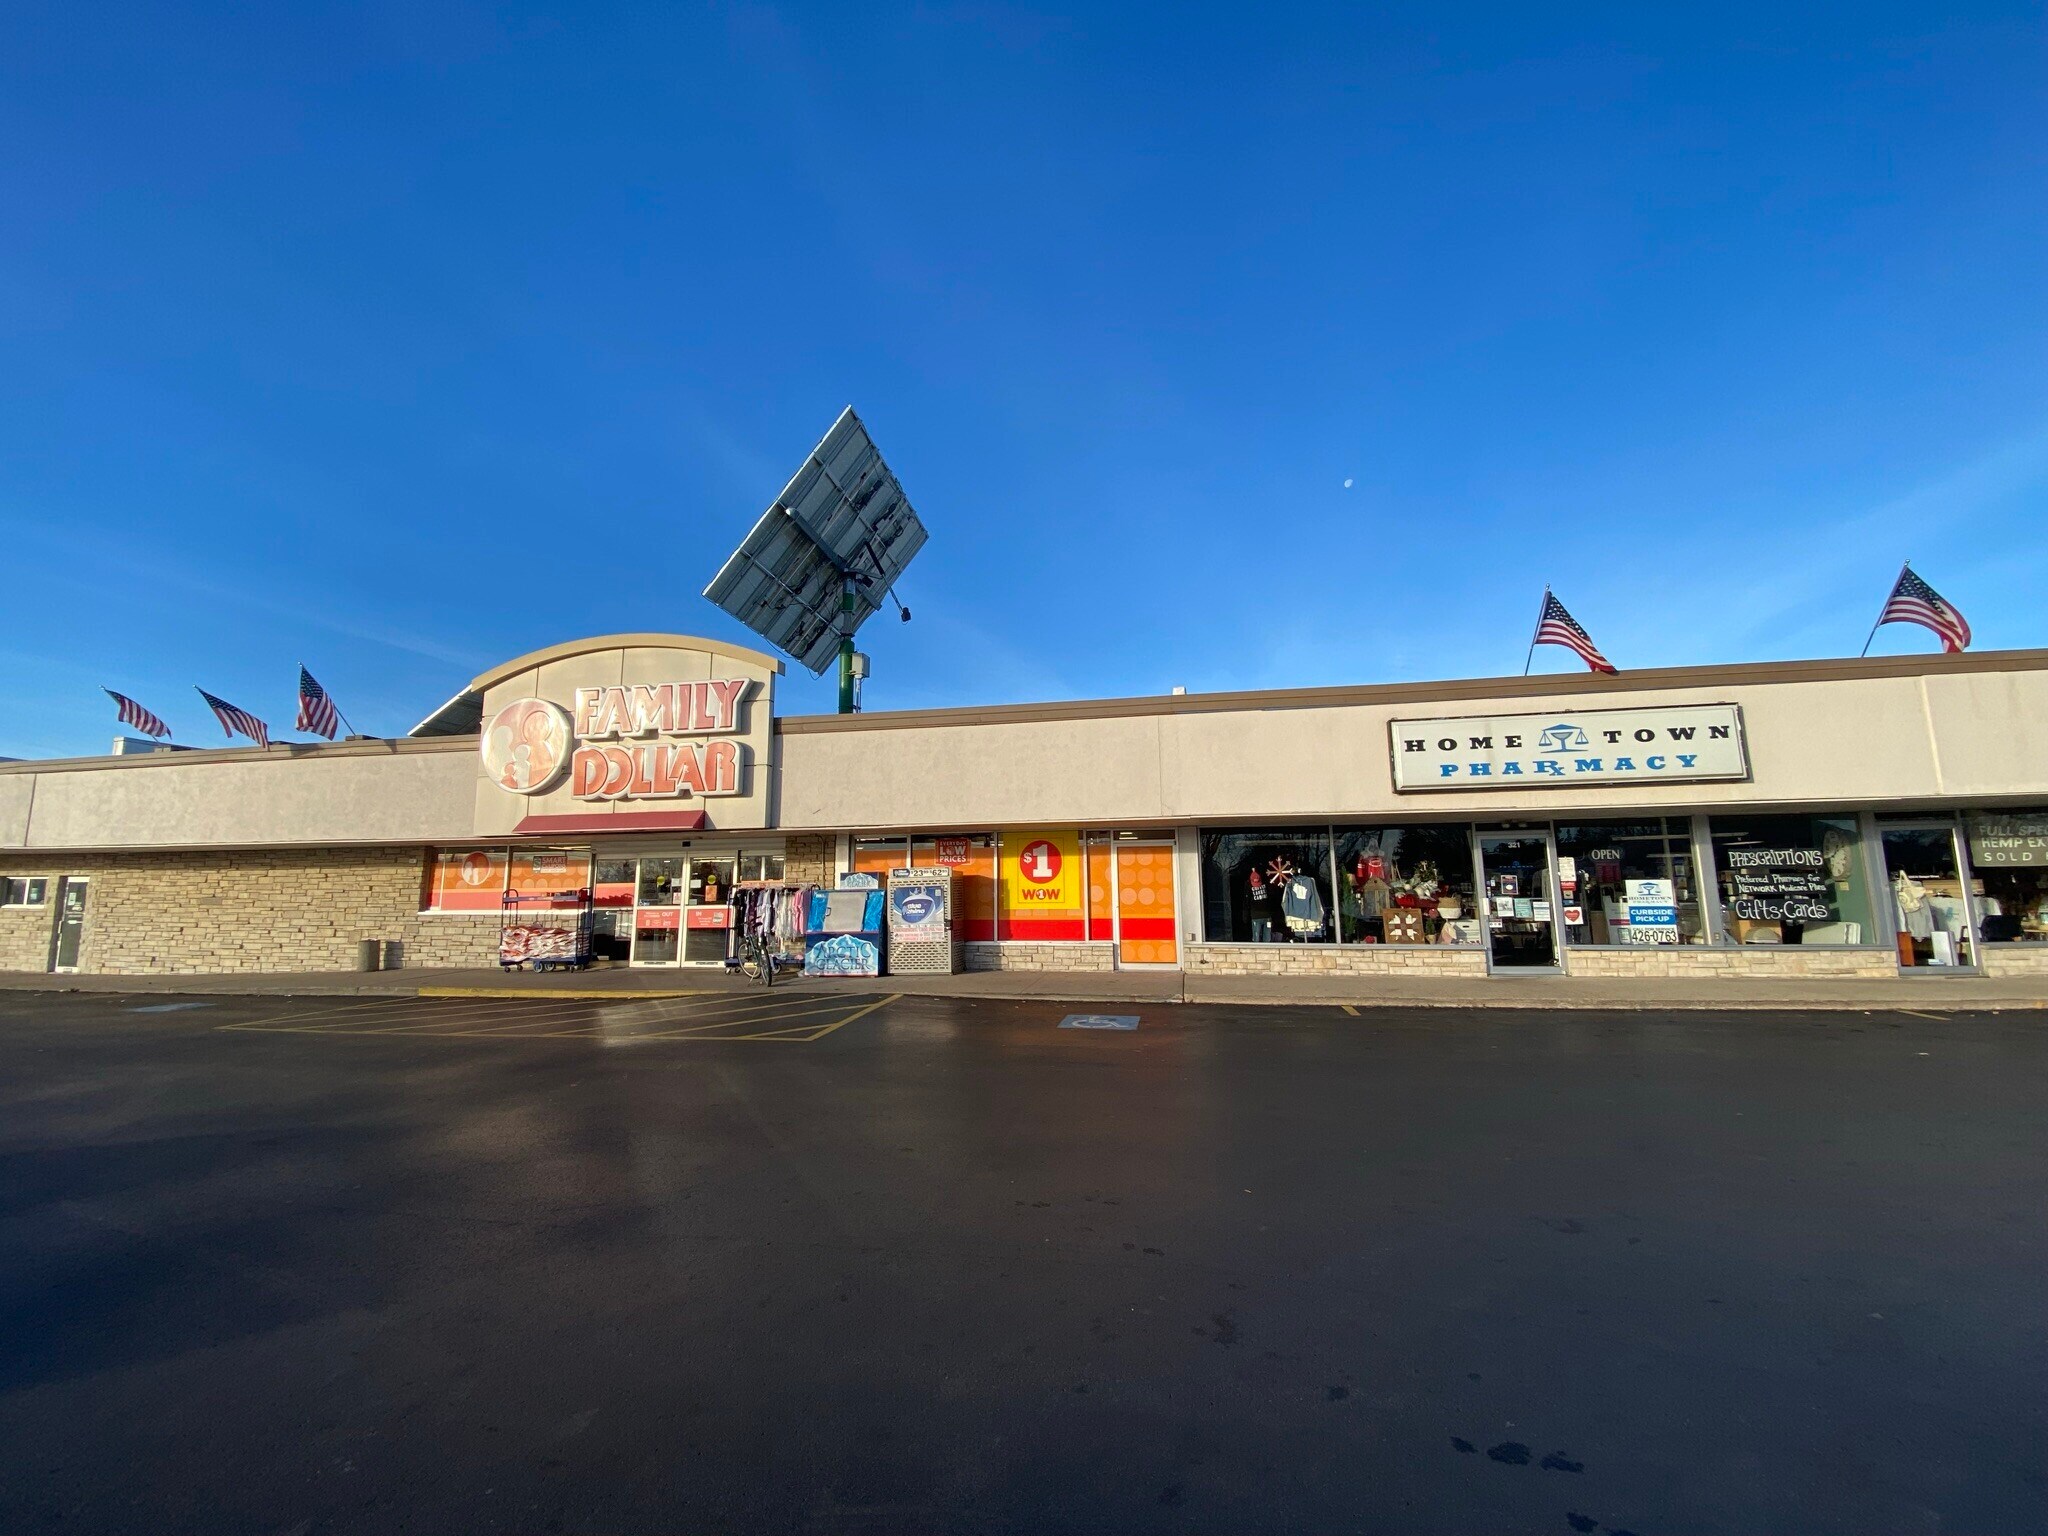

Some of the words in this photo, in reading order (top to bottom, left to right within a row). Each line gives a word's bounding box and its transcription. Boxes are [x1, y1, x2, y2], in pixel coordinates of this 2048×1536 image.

[575, 680, 747, 736] FAMILY
[1404, 735, 1522, 752] HOME
[1603, 725, 1729, 744] TOWN
[573, 741, 739, 797] DOLLAR
[1979, 825, 2014, 836] FULL
[1507, 841, 1521, 849] 321
[1981, 837, 2024, 848] HEMP
[1591, 849, 1621, 860] OPEN
[1983, 852, 2033, 862] SOLD
[1023, 844, 1052, 878] $1
[1738, 884, 1777, 893] NETWORK
[1631, 930, 1677, 942] 426-0763
[815, 942, 872, 958] ARCTIC
[815, 958, 871, 970] GLACIER
